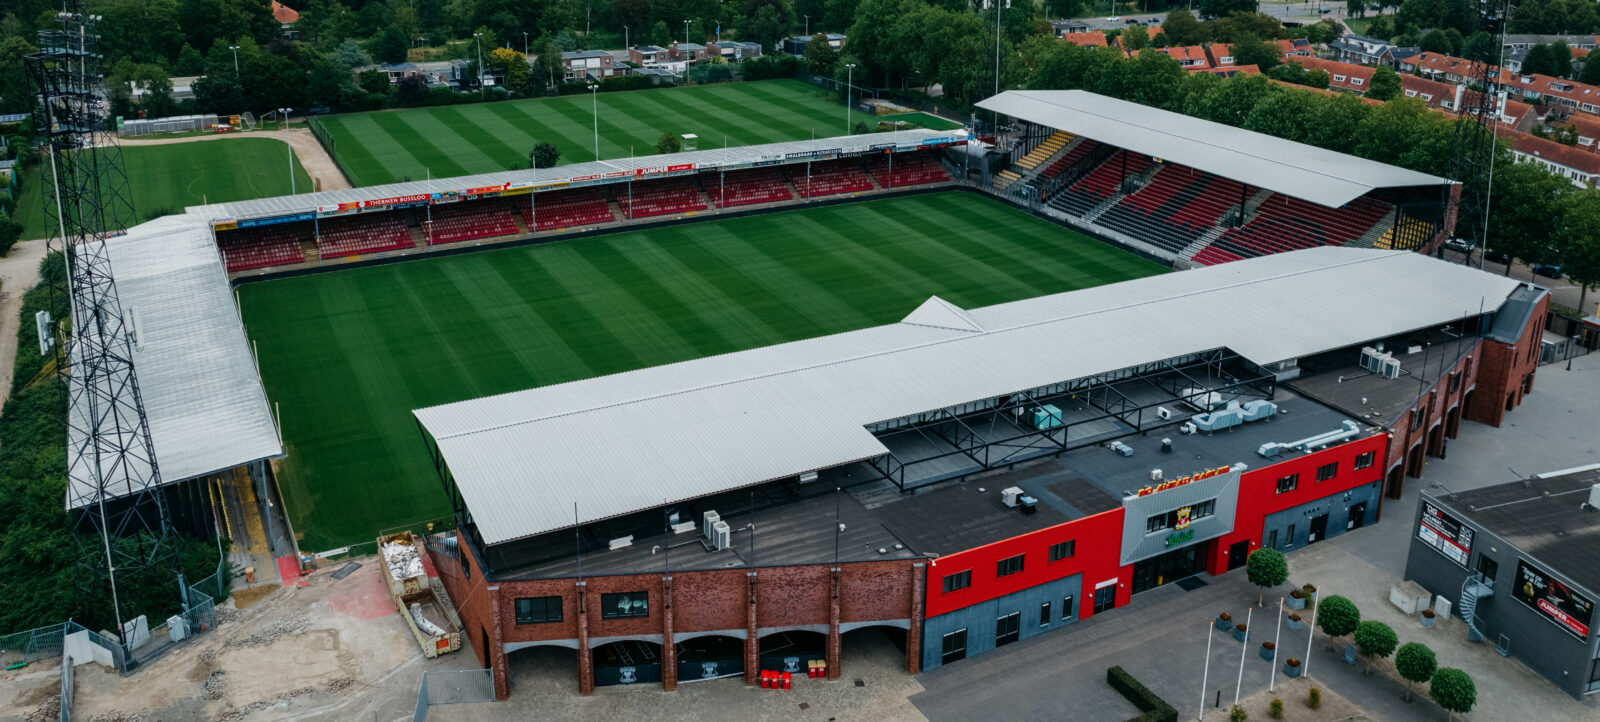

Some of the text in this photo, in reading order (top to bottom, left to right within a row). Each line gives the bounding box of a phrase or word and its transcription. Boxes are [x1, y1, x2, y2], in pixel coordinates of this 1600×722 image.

[641, 166, 669, 175] JUMPER
[369, 197, 398, 206] THERMEN
[400, 194, 426, 203] BUSSLOO
[1540, 601, 1568, 621] JUMPER
